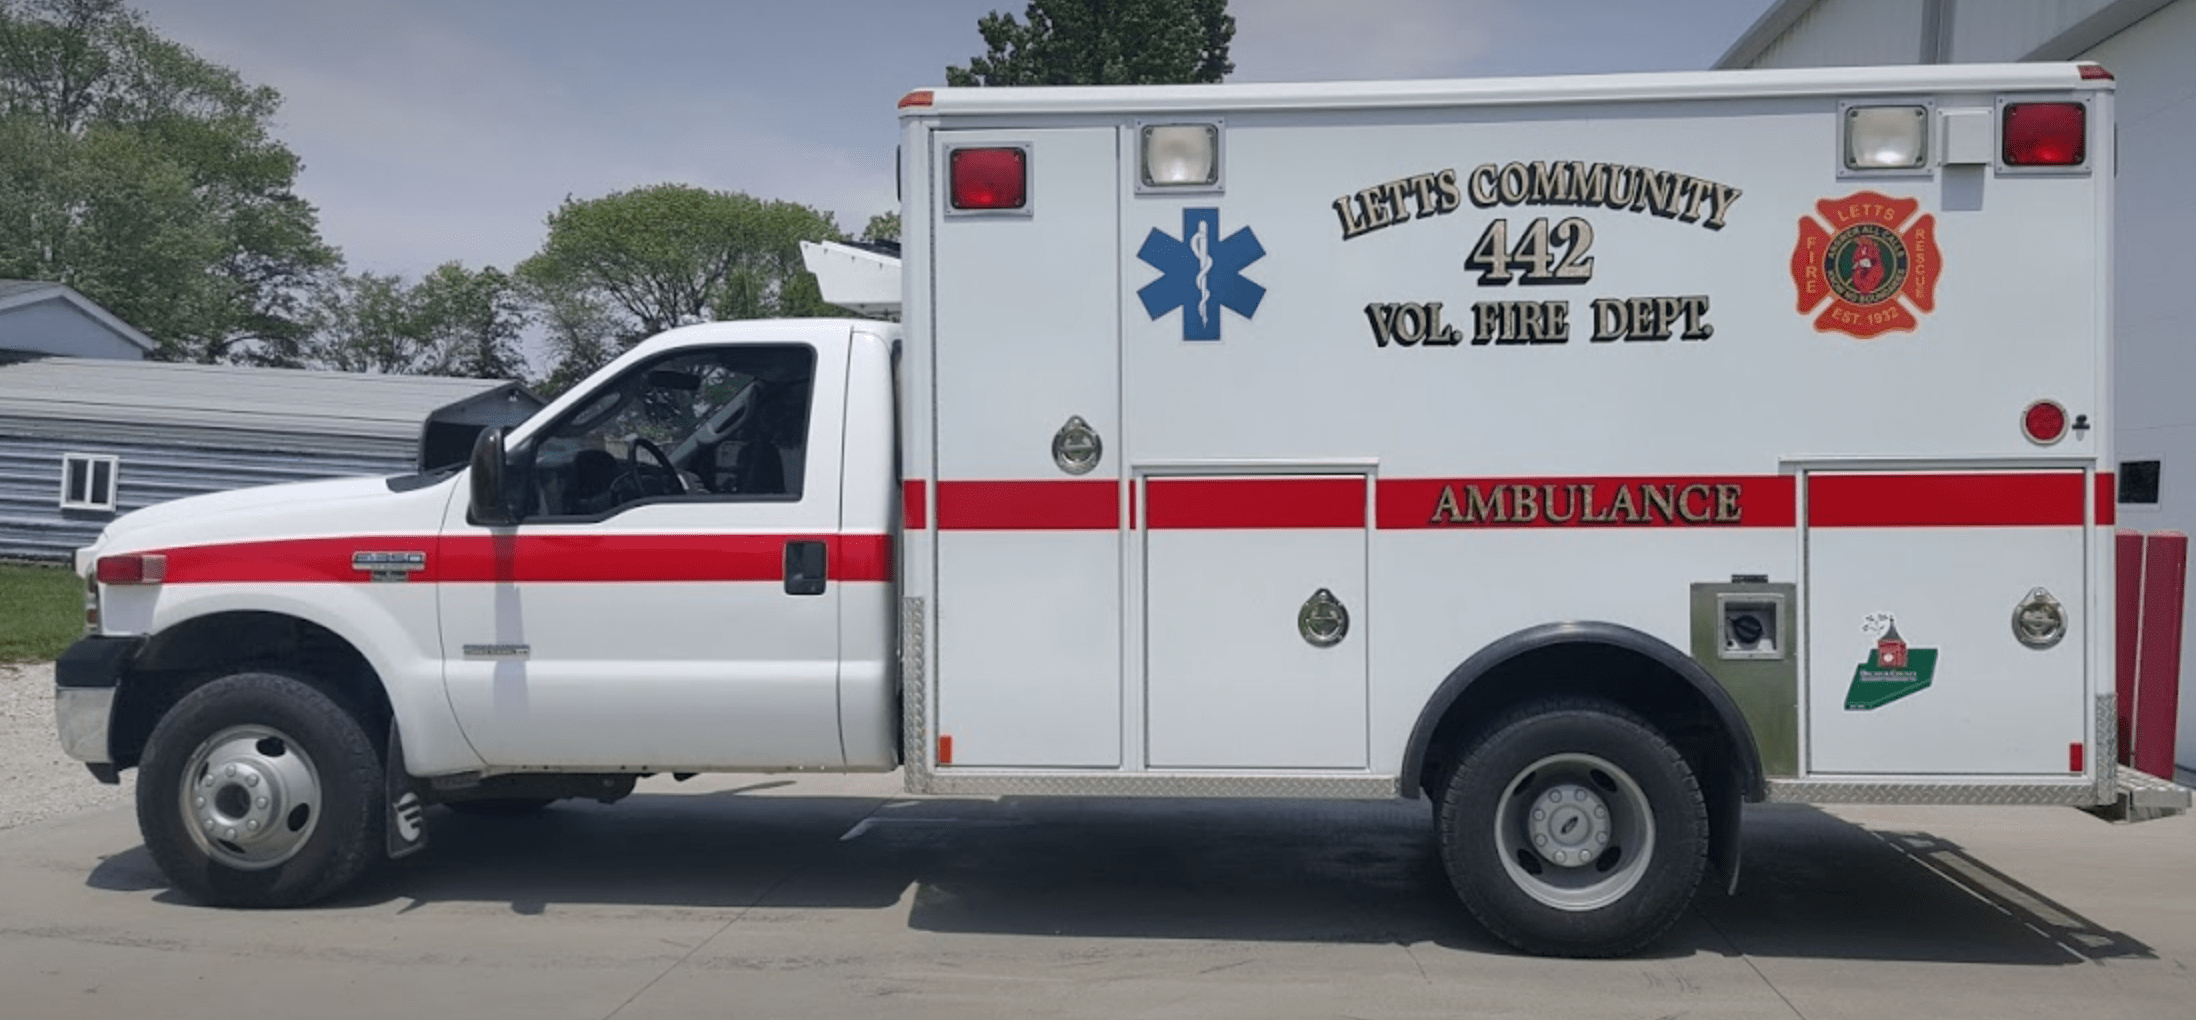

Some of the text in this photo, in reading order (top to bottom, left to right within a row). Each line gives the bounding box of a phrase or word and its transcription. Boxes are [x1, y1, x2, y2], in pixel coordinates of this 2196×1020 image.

[1332, 161, 1743, 240] LETTS COMMUNITY
[1837, 204, 1895, 222] LETTS
[1464, 217, 1594, 286] 442
[1806, 236, 1818, 293] FIRE
[1915, 228, 1926, 299] RESCUE
[1365, 296, 1714, 347] VOL. FIRE DEPT.
[1831, 307, 1899, 326] EST. 1932
[1428, 483, 1743, 524] AMBULANCE
